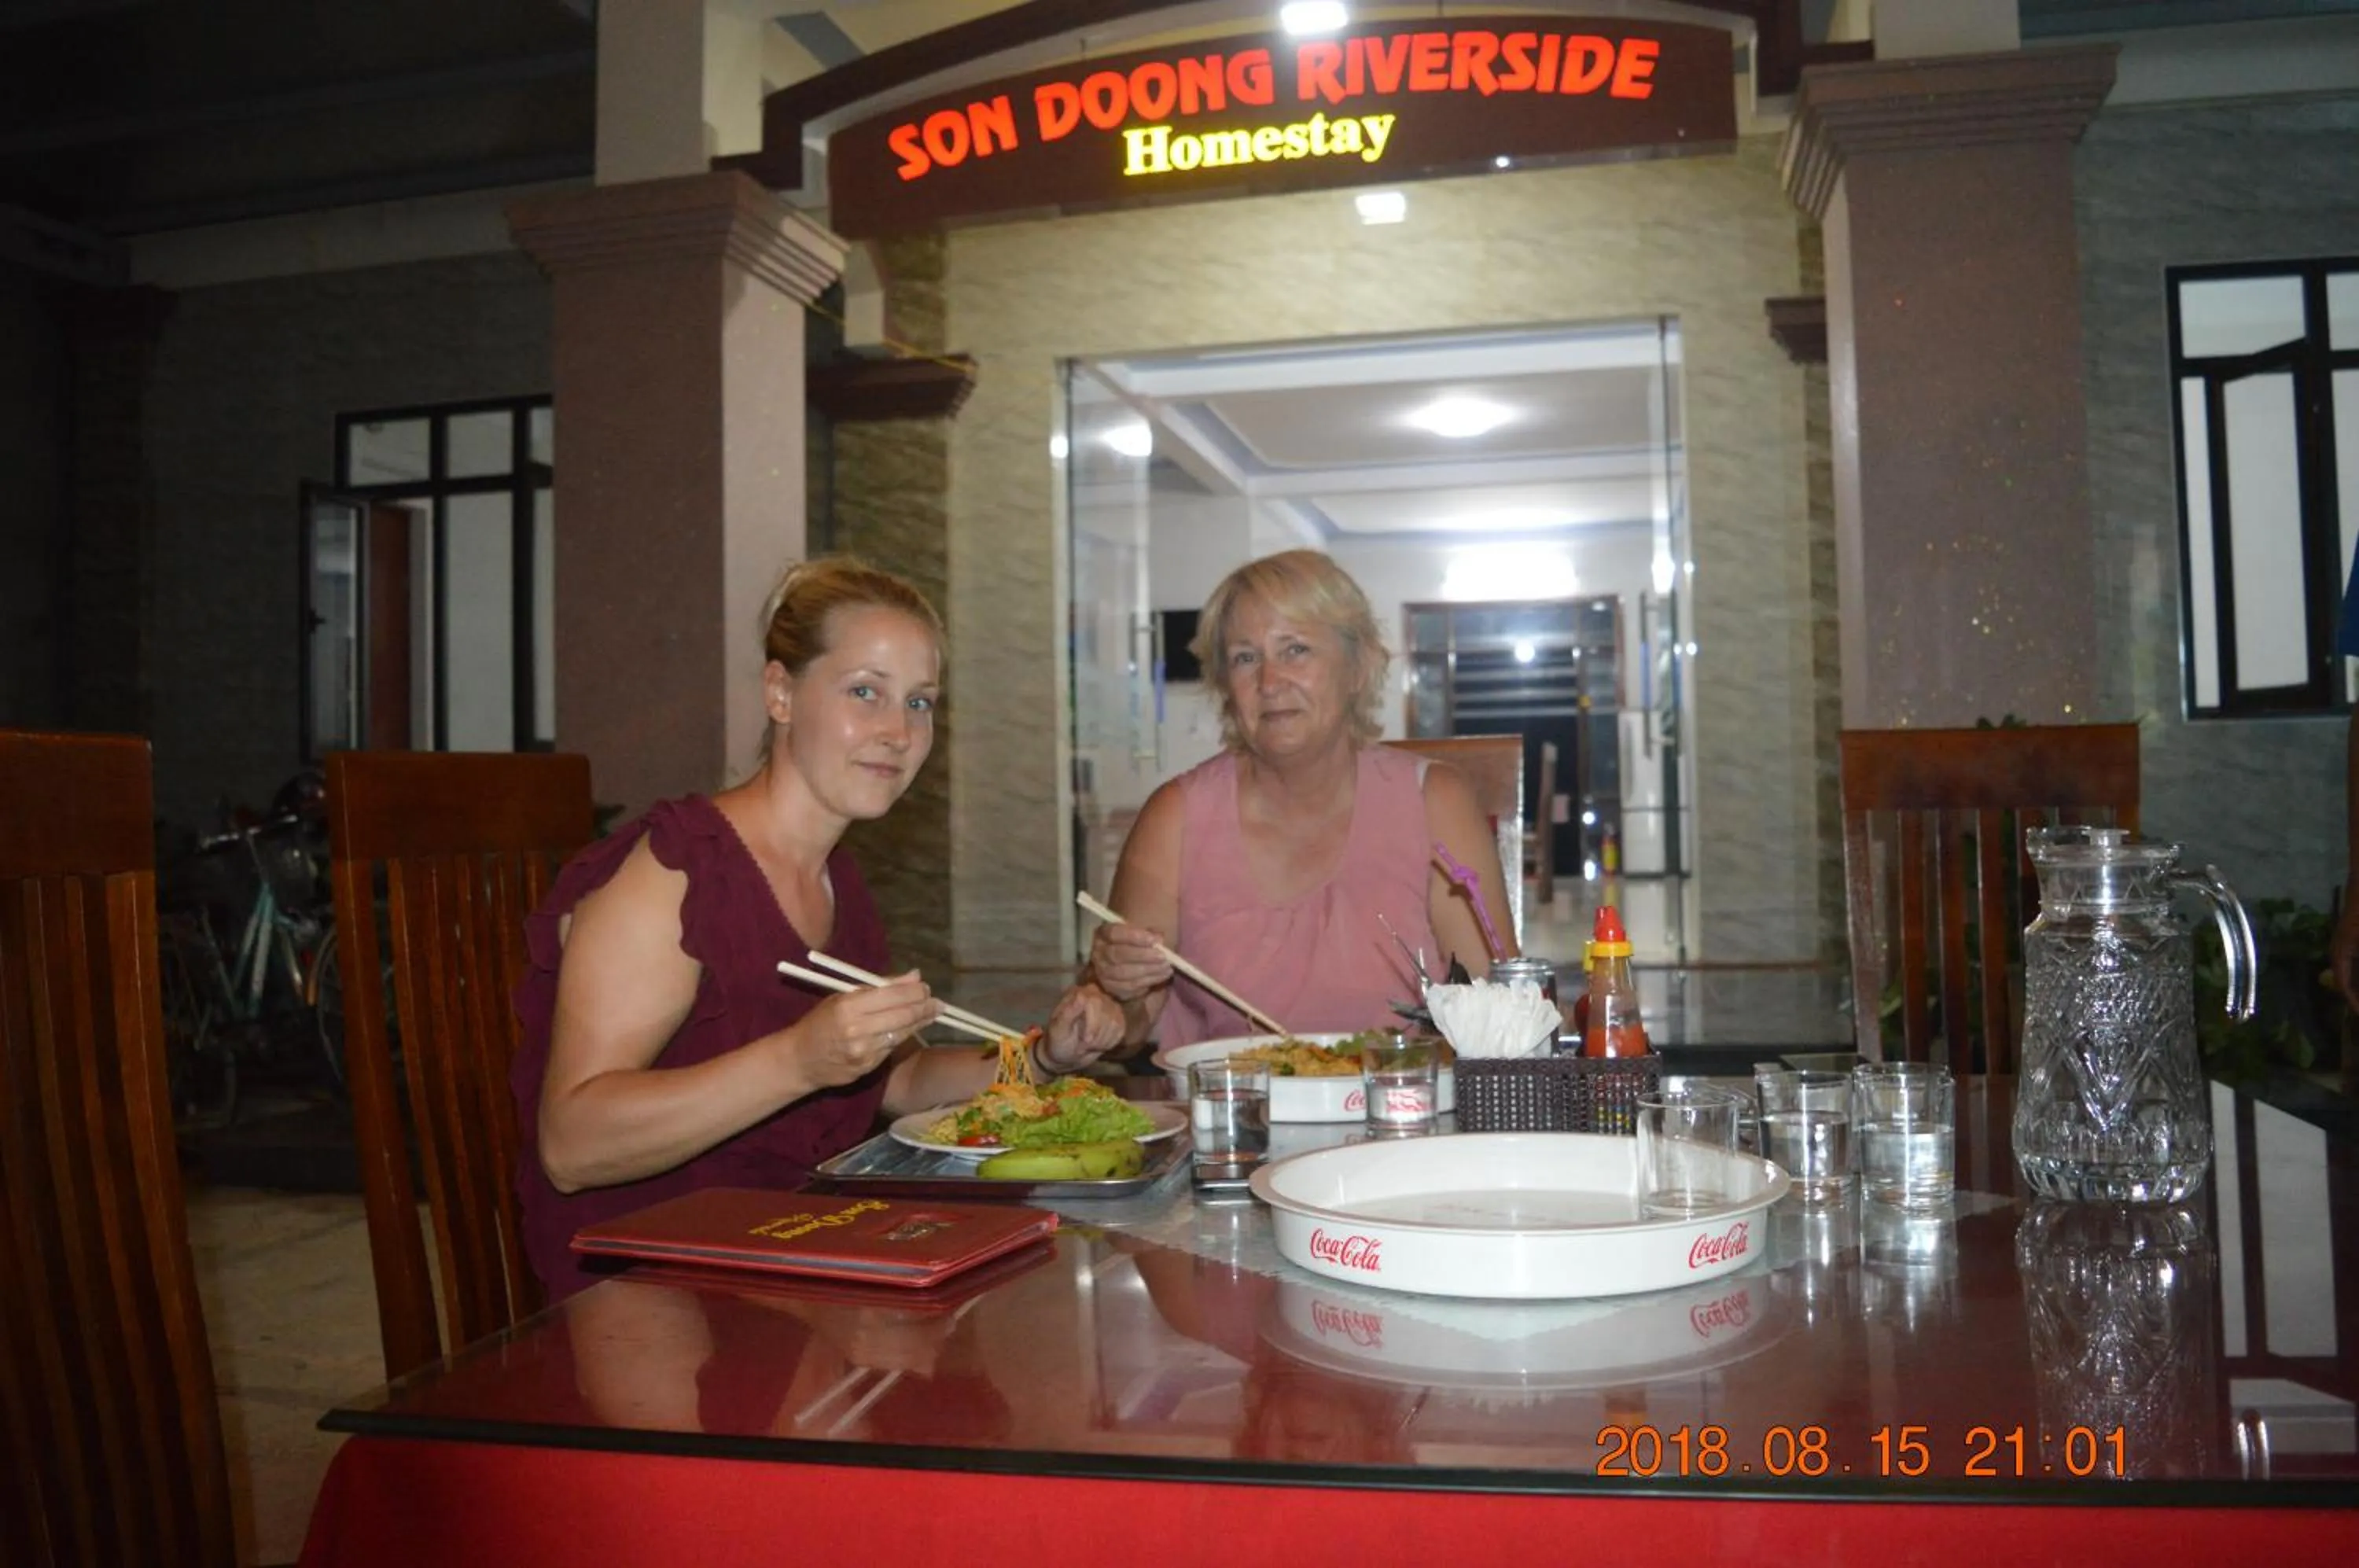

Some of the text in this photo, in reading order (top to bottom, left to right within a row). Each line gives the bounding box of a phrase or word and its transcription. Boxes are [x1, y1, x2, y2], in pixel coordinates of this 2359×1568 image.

[888, 31, 1660, 181] SON DOONG RIVERSIDE
[1123, 112, 1396, 176] Homestay
